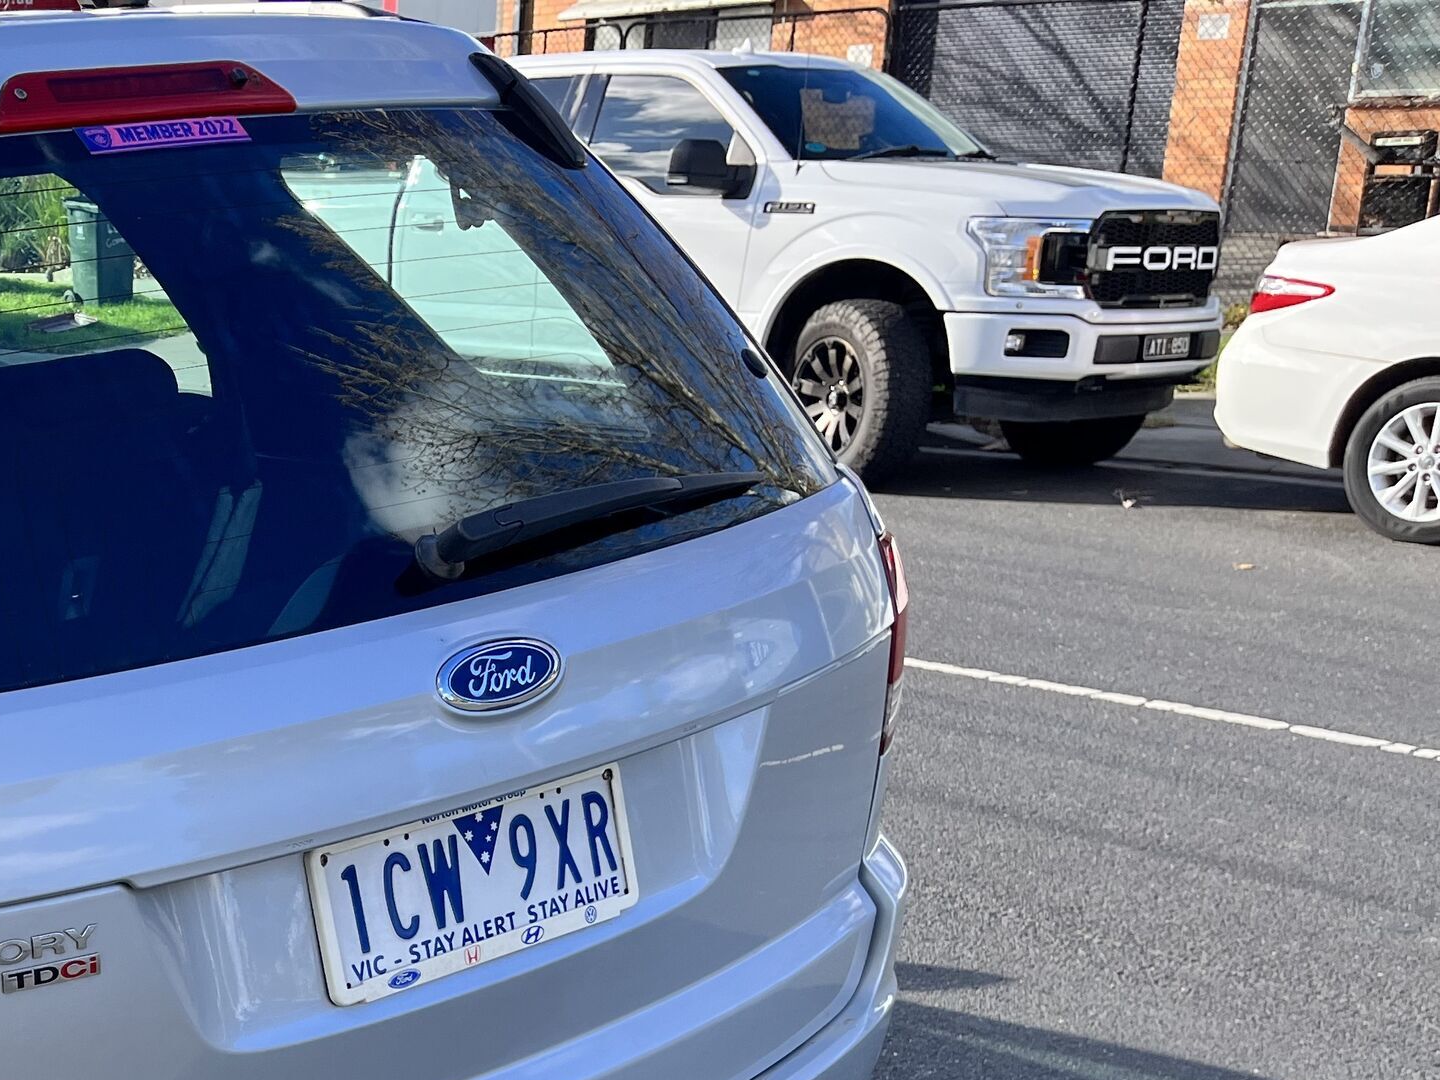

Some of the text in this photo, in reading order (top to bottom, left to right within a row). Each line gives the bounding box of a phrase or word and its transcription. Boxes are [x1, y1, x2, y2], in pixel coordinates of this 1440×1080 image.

[114, 118, 238, 143] MEMBER 2022
[1106, 245, 1218, 271] FORD
[468, 650, 536, 697] Ford
[351, 954, 388, 982] VIC
[408, 931, 455, 964] STAY
[462, 911, 516, 947] ALERT
[527, 892, 569, 924] STAY
[574, 875, 620, 909] ALIVE
[5, 954, 100, 991] TDCi
